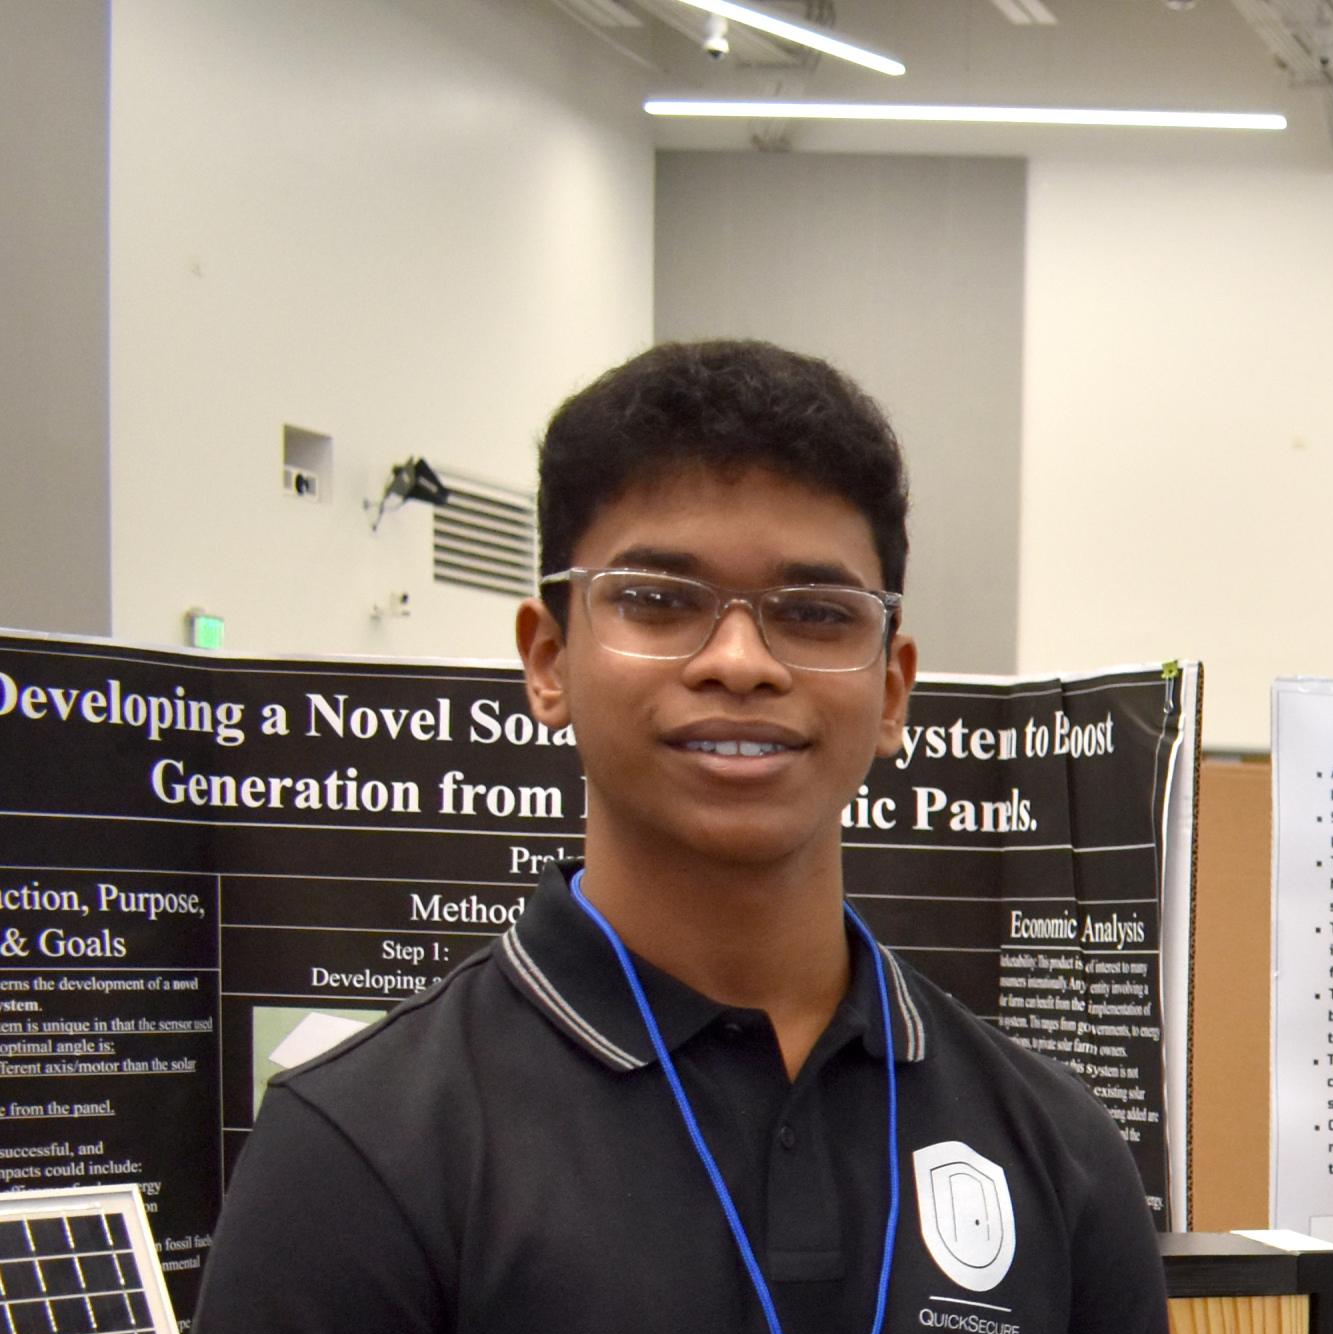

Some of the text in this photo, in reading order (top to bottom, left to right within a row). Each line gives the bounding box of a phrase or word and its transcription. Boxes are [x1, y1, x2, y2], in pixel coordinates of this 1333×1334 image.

[261, 704, 289, 735] a
[306, 693, 452, 741] Novel
[1025, 716, 1050, 758] to
[1053, 710, 1115, 759] Boost
[151, 759, 421, 812] Generation
[439, 773, 564, 818] from
[98, 886, 204, 920] Purpose,
[0, 928, 126, 957] & Goals
[1011, 910, 1144, 949] Economic Analysis
[382, 940, 448, 965] Step 1:
[32, 977, 55, 990] the
[58, 977, 144, 993] development
[147, 977, 162, 990] of
[162, 980, 170, 990] a
[172, 977, 198, 990] novel
[311, 967, 426, 994] Developing
[56, 1039, 94, 1052] angle
[96, 1039, 115, 1052] is:
[10, 1100, 115, 1114] from the panel.
